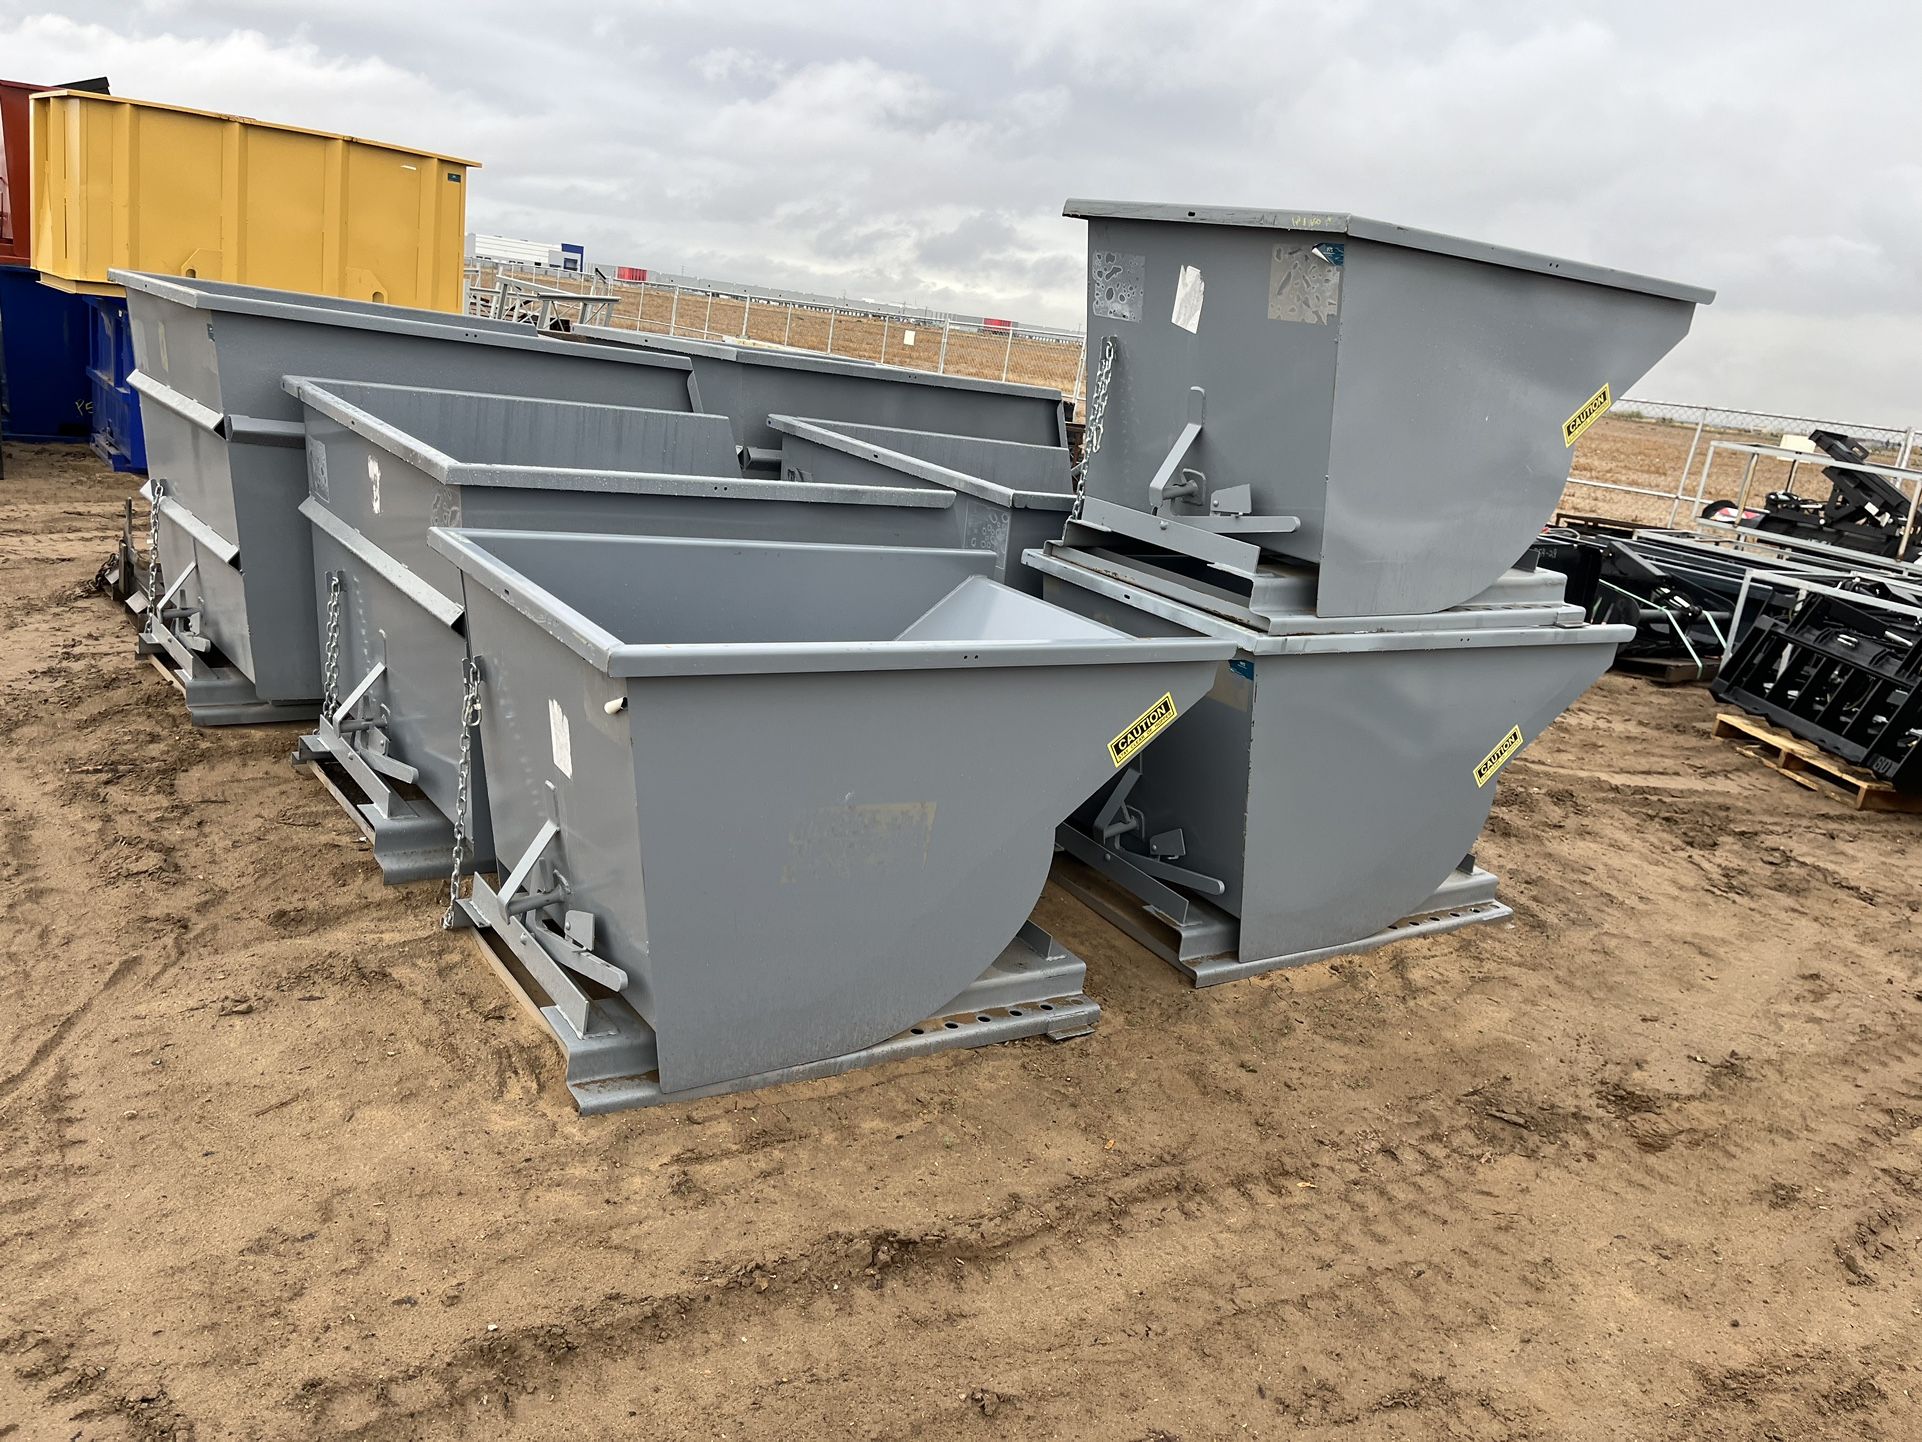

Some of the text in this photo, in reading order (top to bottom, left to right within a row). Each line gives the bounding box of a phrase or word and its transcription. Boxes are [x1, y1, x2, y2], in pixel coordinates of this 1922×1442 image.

[1569, 392, 1605, 433] CAUTION
[1118, 704, 1167, 750] CAUTION
[1481, 735, 1515, 774] CAUTION
